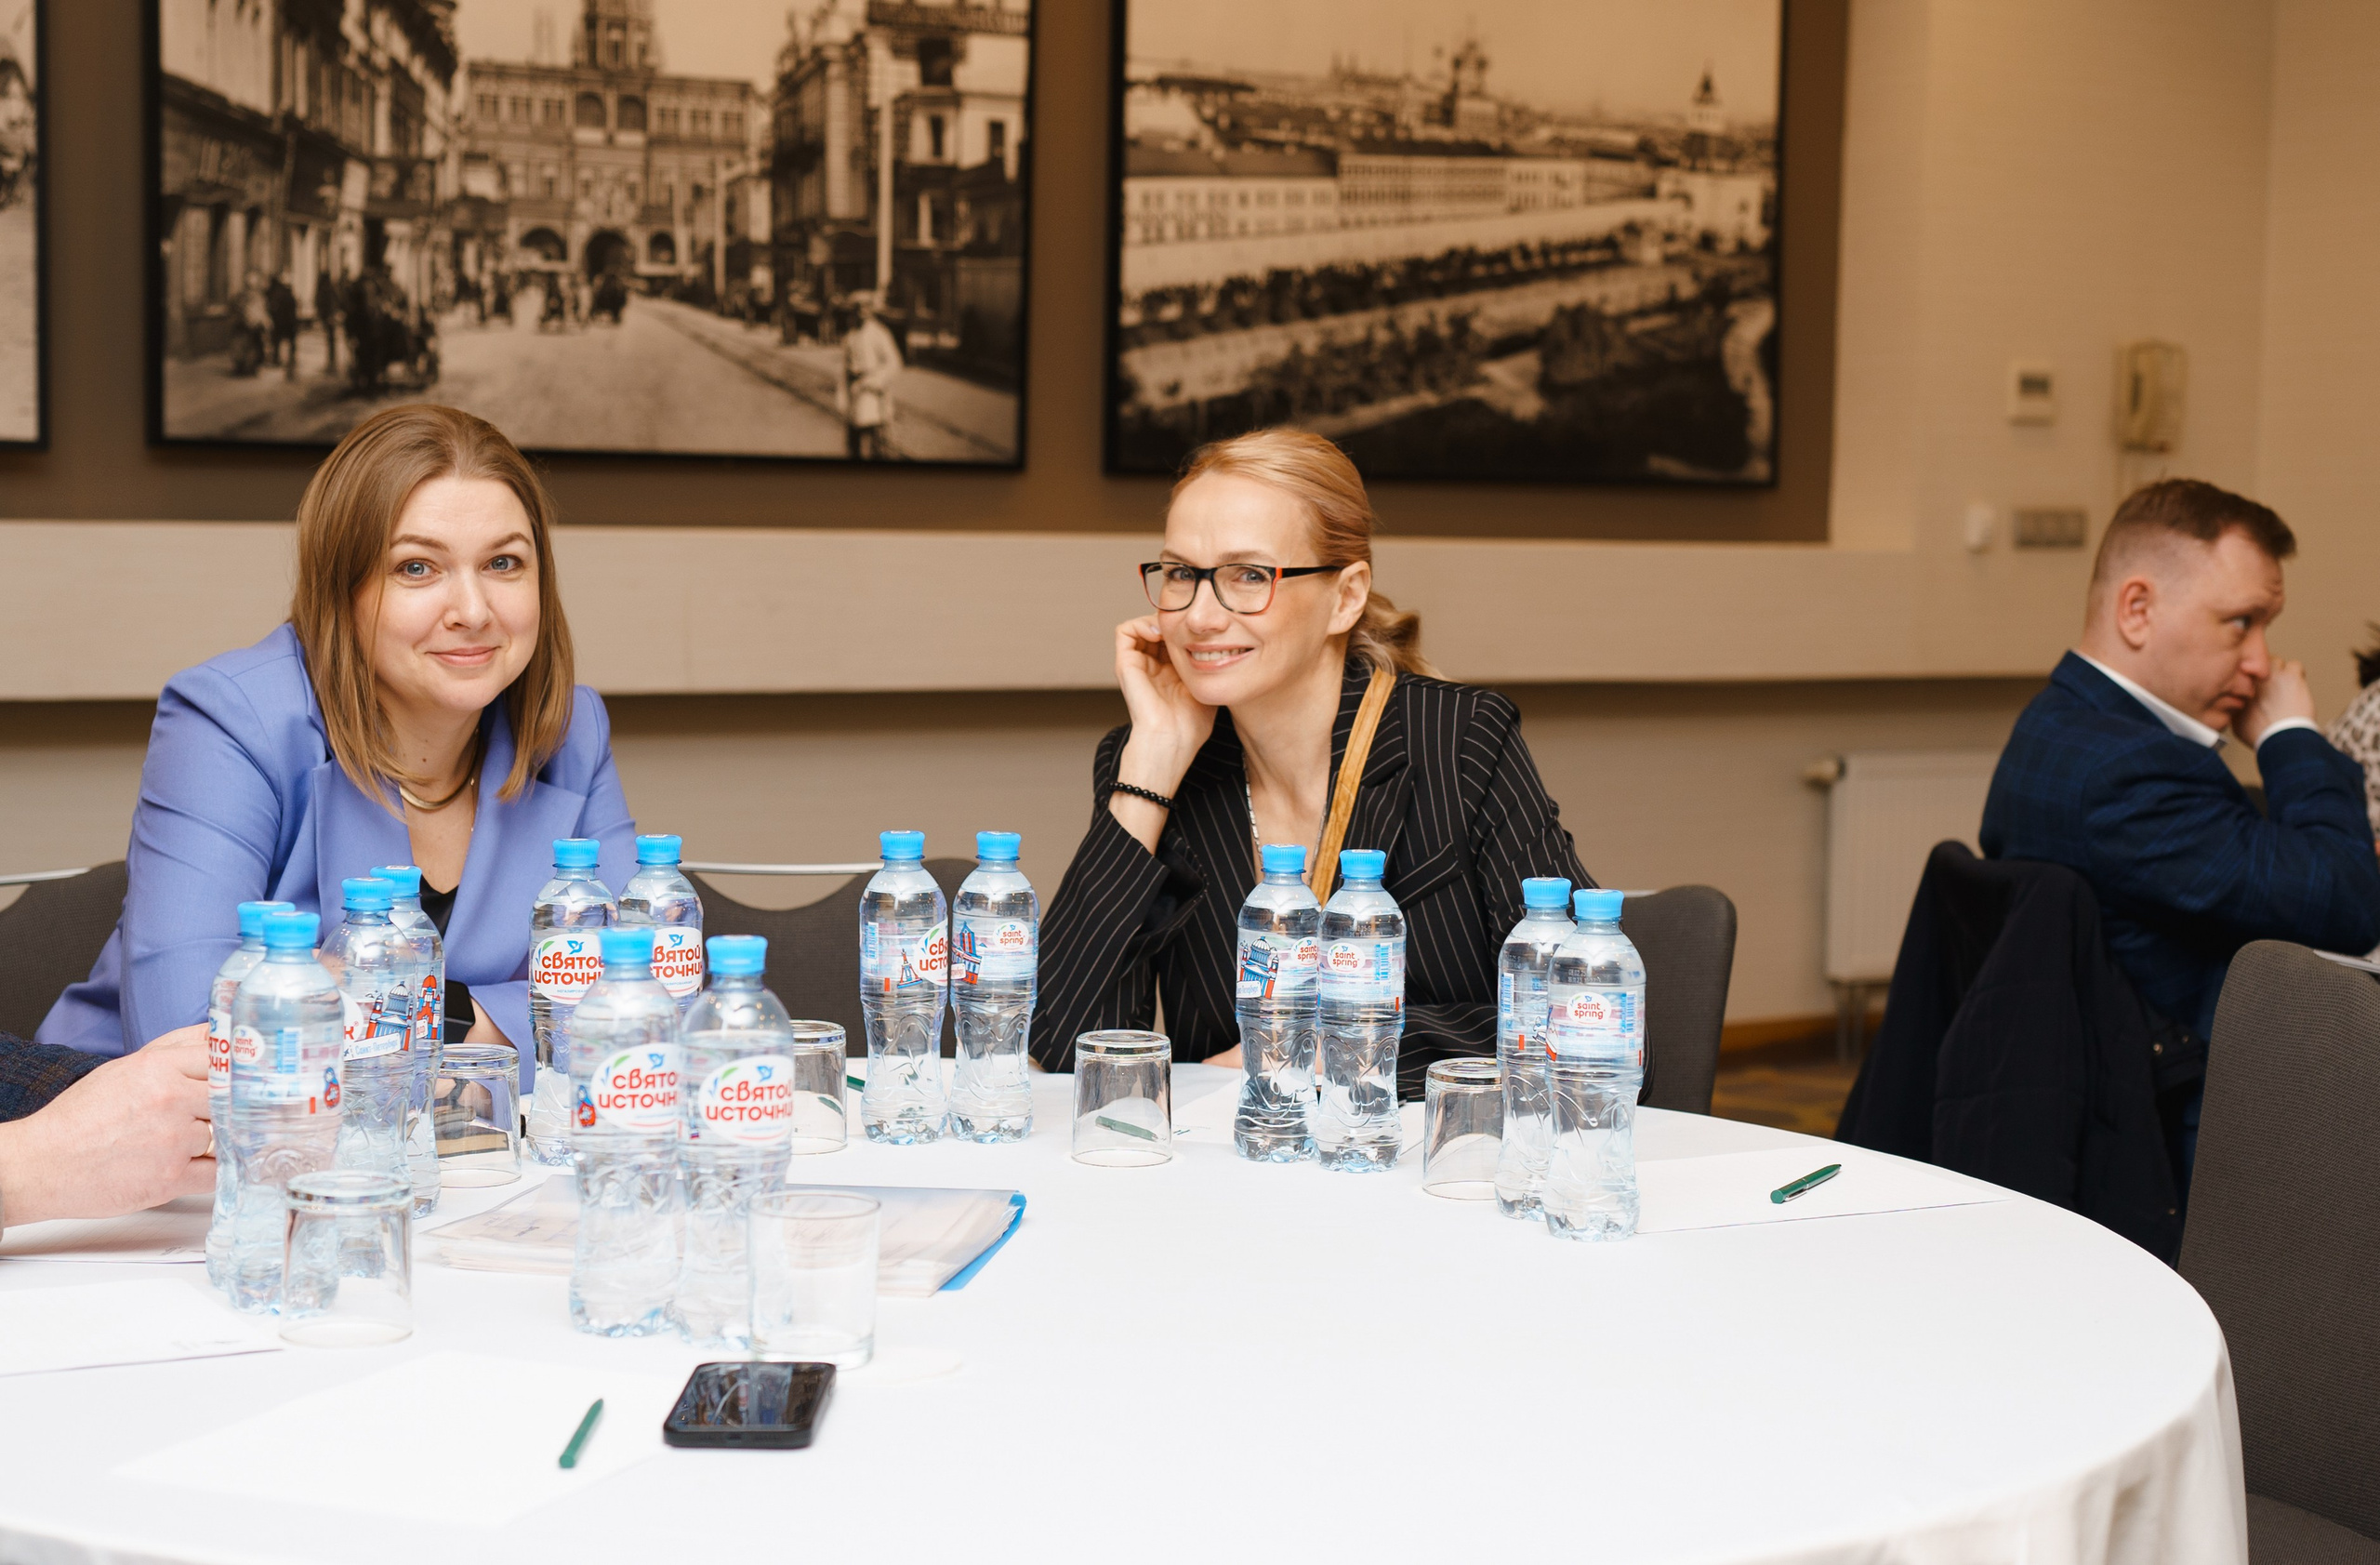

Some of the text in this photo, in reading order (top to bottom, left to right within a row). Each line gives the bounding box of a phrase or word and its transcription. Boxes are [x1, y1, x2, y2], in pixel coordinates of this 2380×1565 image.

[1002, 929, 1022, 937] saint
[999, 936, 1025, 946] spring
[1335, 951, 1355, 960] saint
[1332, 959, 1358, 969] spring
[1577, 1002, 1601, 1011] saint
[1574, 1009, 1604, 1020] spring
